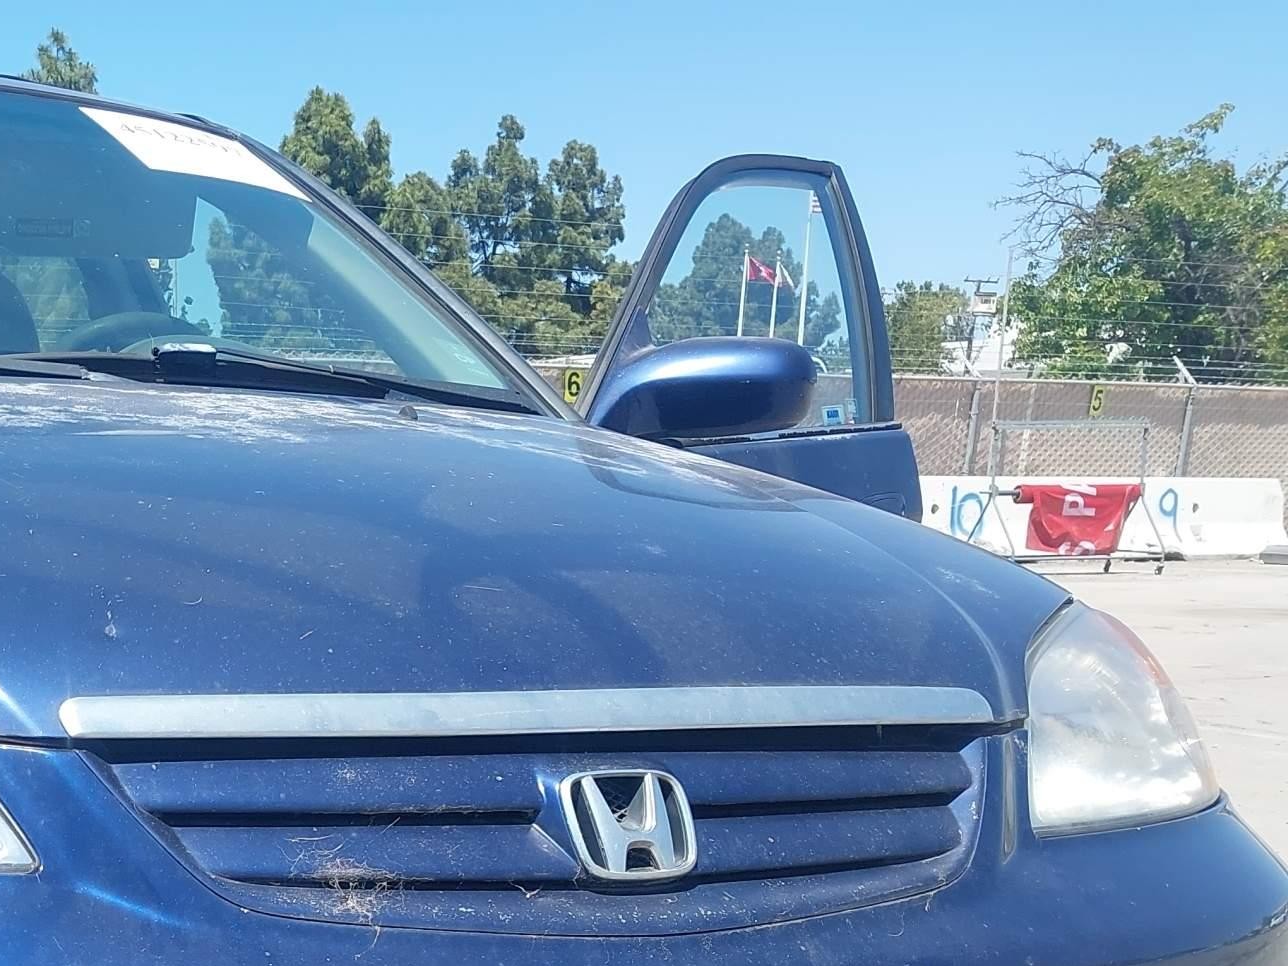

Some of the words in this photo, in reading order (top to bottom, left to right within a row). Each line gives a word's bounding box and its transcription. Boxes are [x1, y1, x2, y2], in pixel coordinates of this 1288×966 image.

[567, 371, 581, 397] 6
[1091, 389, 1104, 411] 5
[950, 485, 984, 536] 10
[1159, 487, 1183, 543] 9
